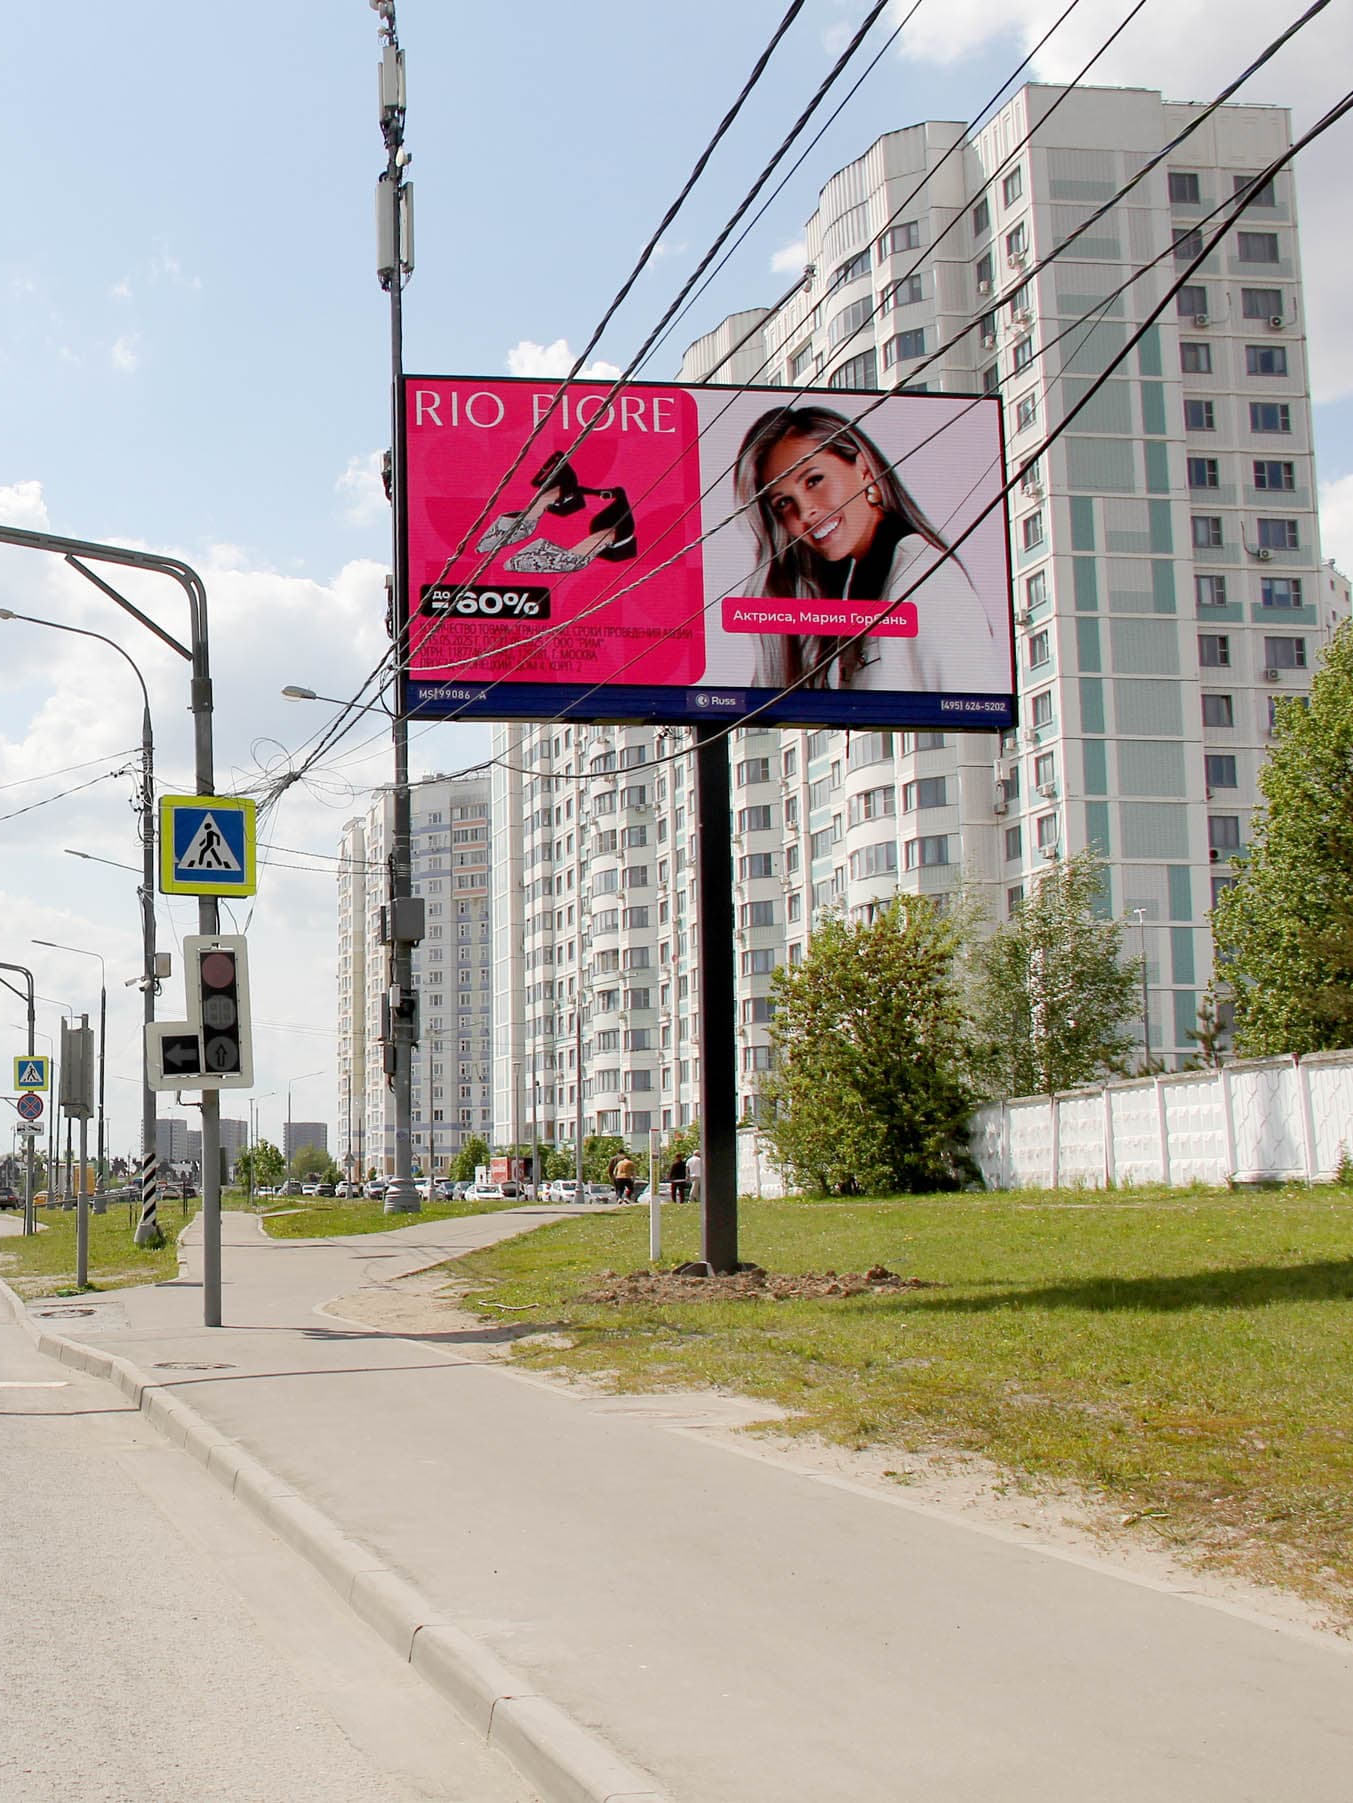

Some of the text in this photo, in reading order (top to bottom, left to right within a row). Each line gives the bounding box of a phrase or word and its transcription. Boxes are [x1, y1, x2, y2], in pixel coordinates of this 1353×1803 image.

[415, 389, 676, 434] RIO FIORE
[432, 591, 450, 600] до
[733, 610, 796, 624] Актриса,
[800, 612, 846, 625] Мария
[711, 696, 736, 705] Russ
[965, 701, 1006, 711] 626-5202
